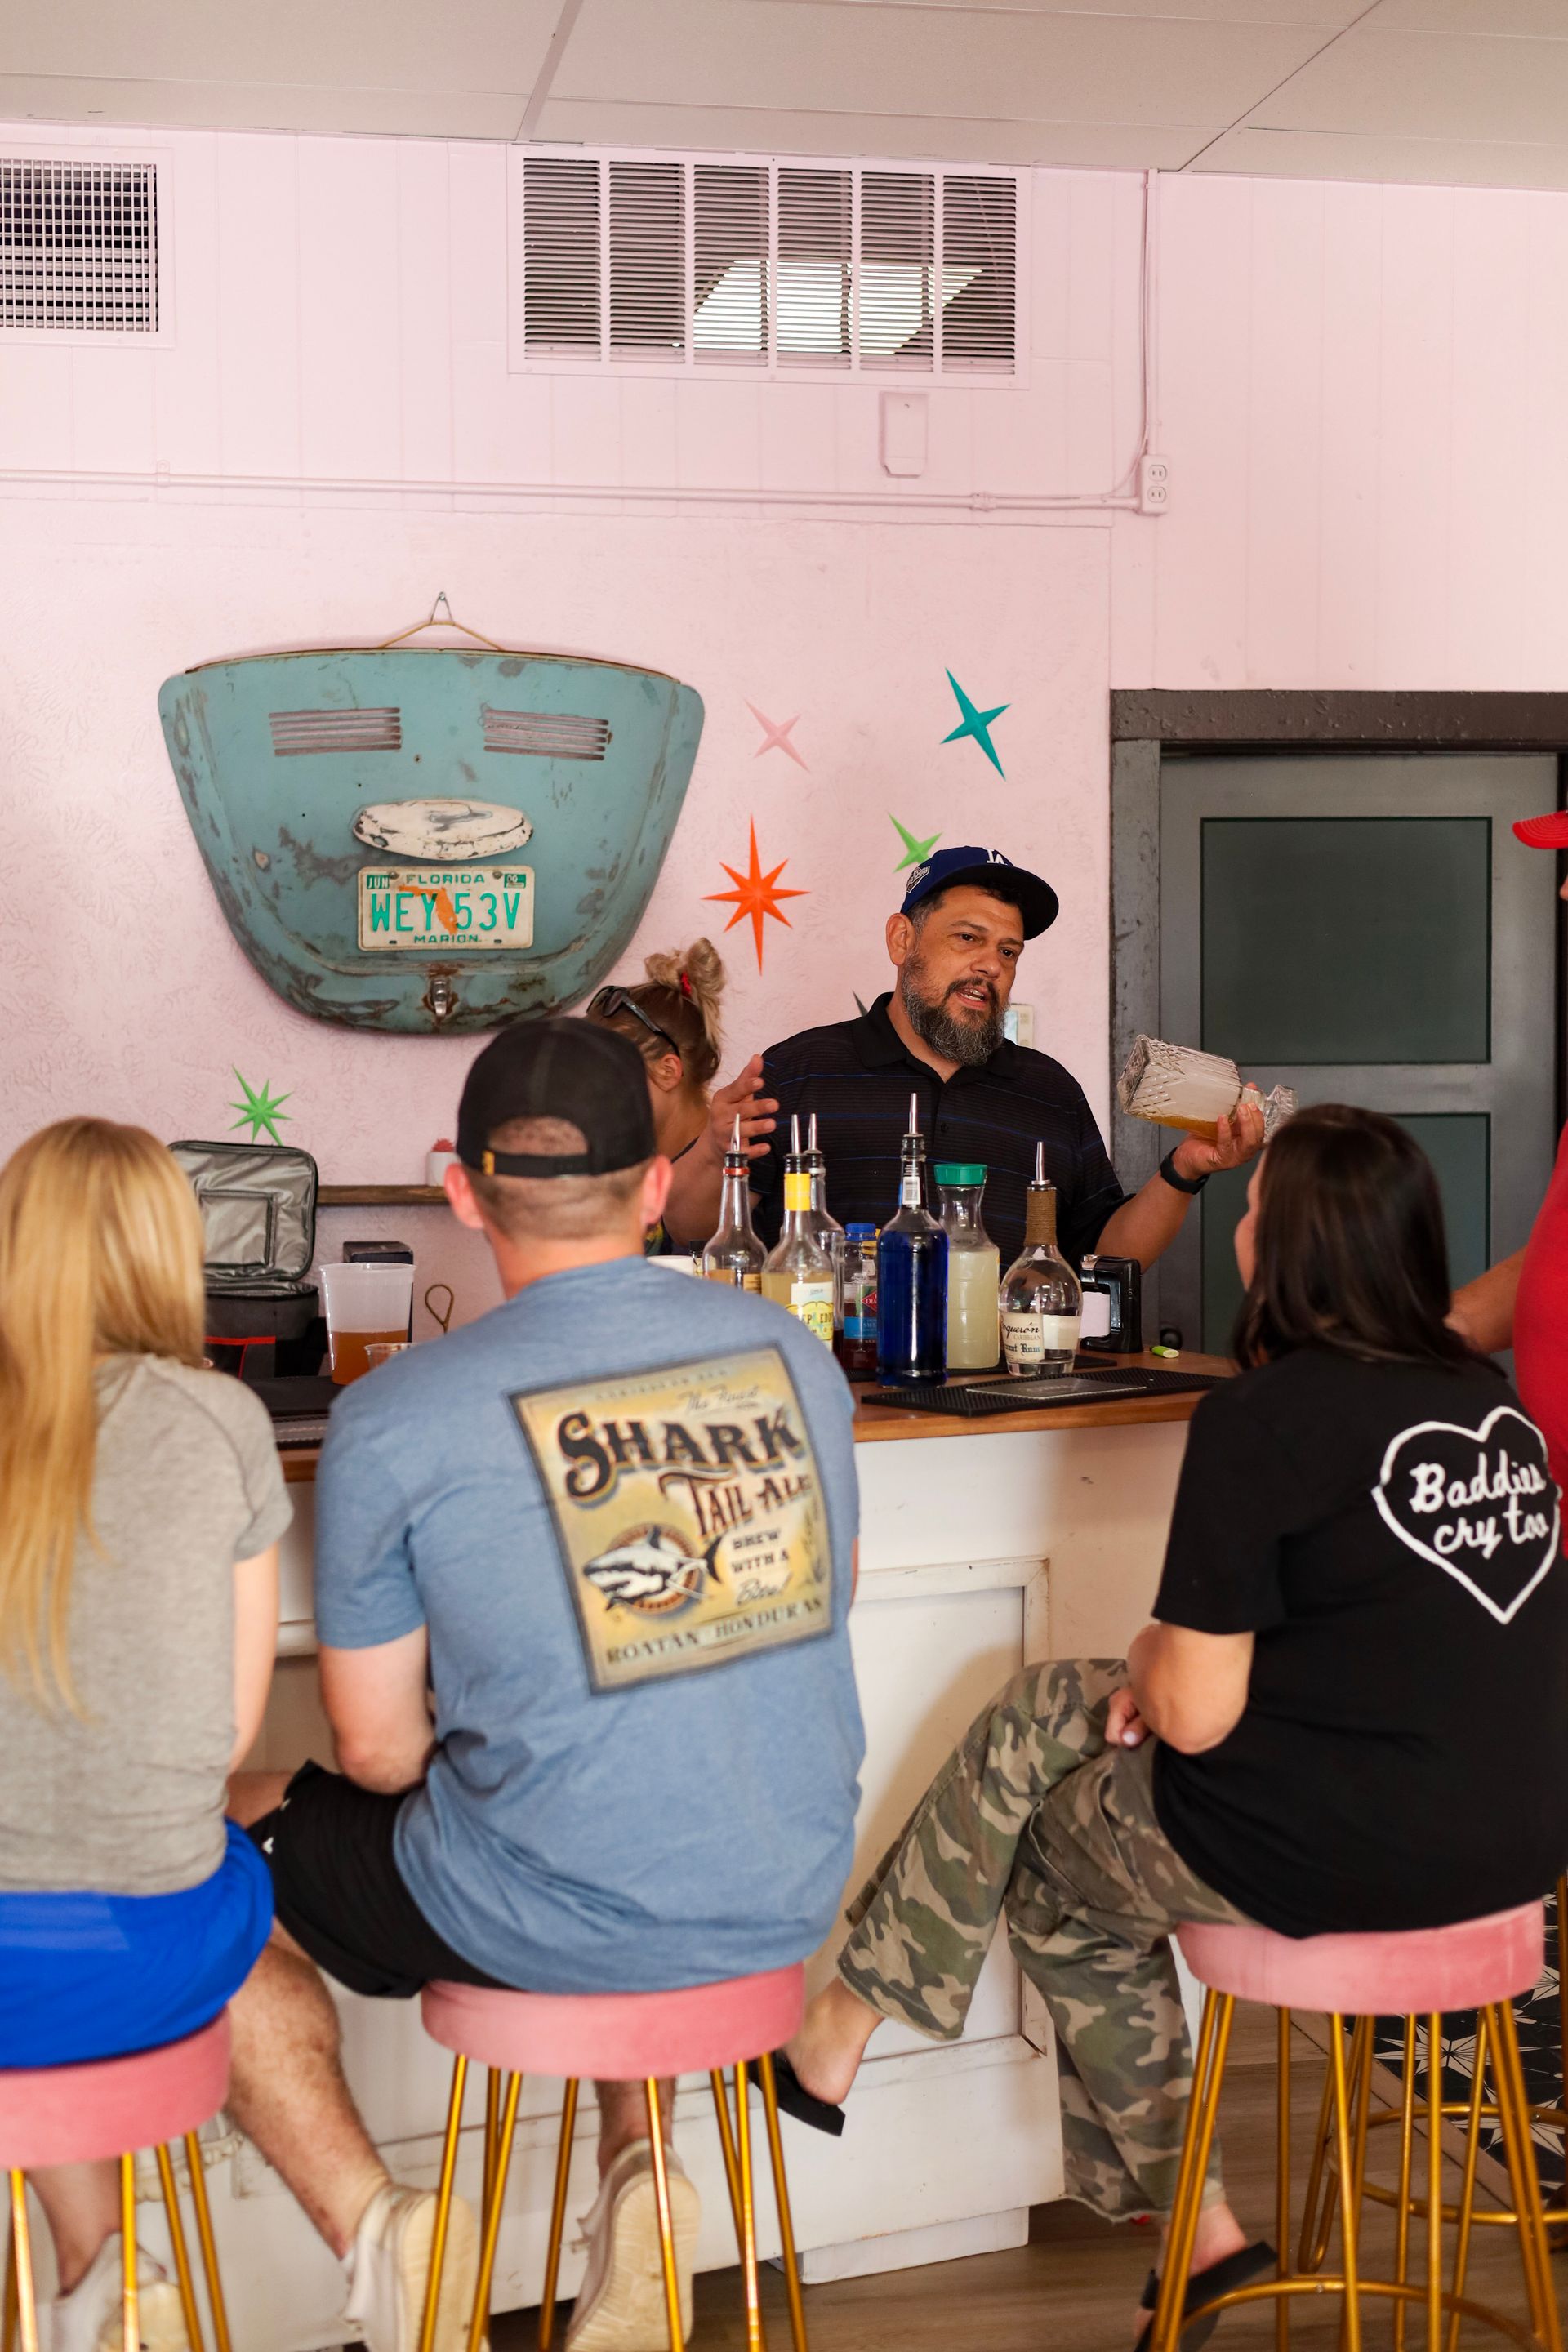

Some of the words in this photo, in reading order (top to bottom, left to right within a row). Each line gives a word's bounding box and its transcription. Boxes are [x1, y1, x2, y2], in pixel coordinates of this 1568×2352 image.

[368, 875, 389, 889] JUN
[406, 874, 485, 884] FLORIDA
[371, 893, 439, 932] WEY
[454, 892, 521, 931] 53V
[414, 934, 479, 943] MARION
[558, 1406, 804, 1500] SHARK
[1409, 1449, 1547, 1513] Baddies
[658, 1467, 753, 1540] TAIL
[1433, 1517, 1503, 1559] cry
[732, 1552, 775, 1573] WITH
[606, 1631, 701, 1665] ROATAN
[715, 1597, 822, 1639] HONDURAS
